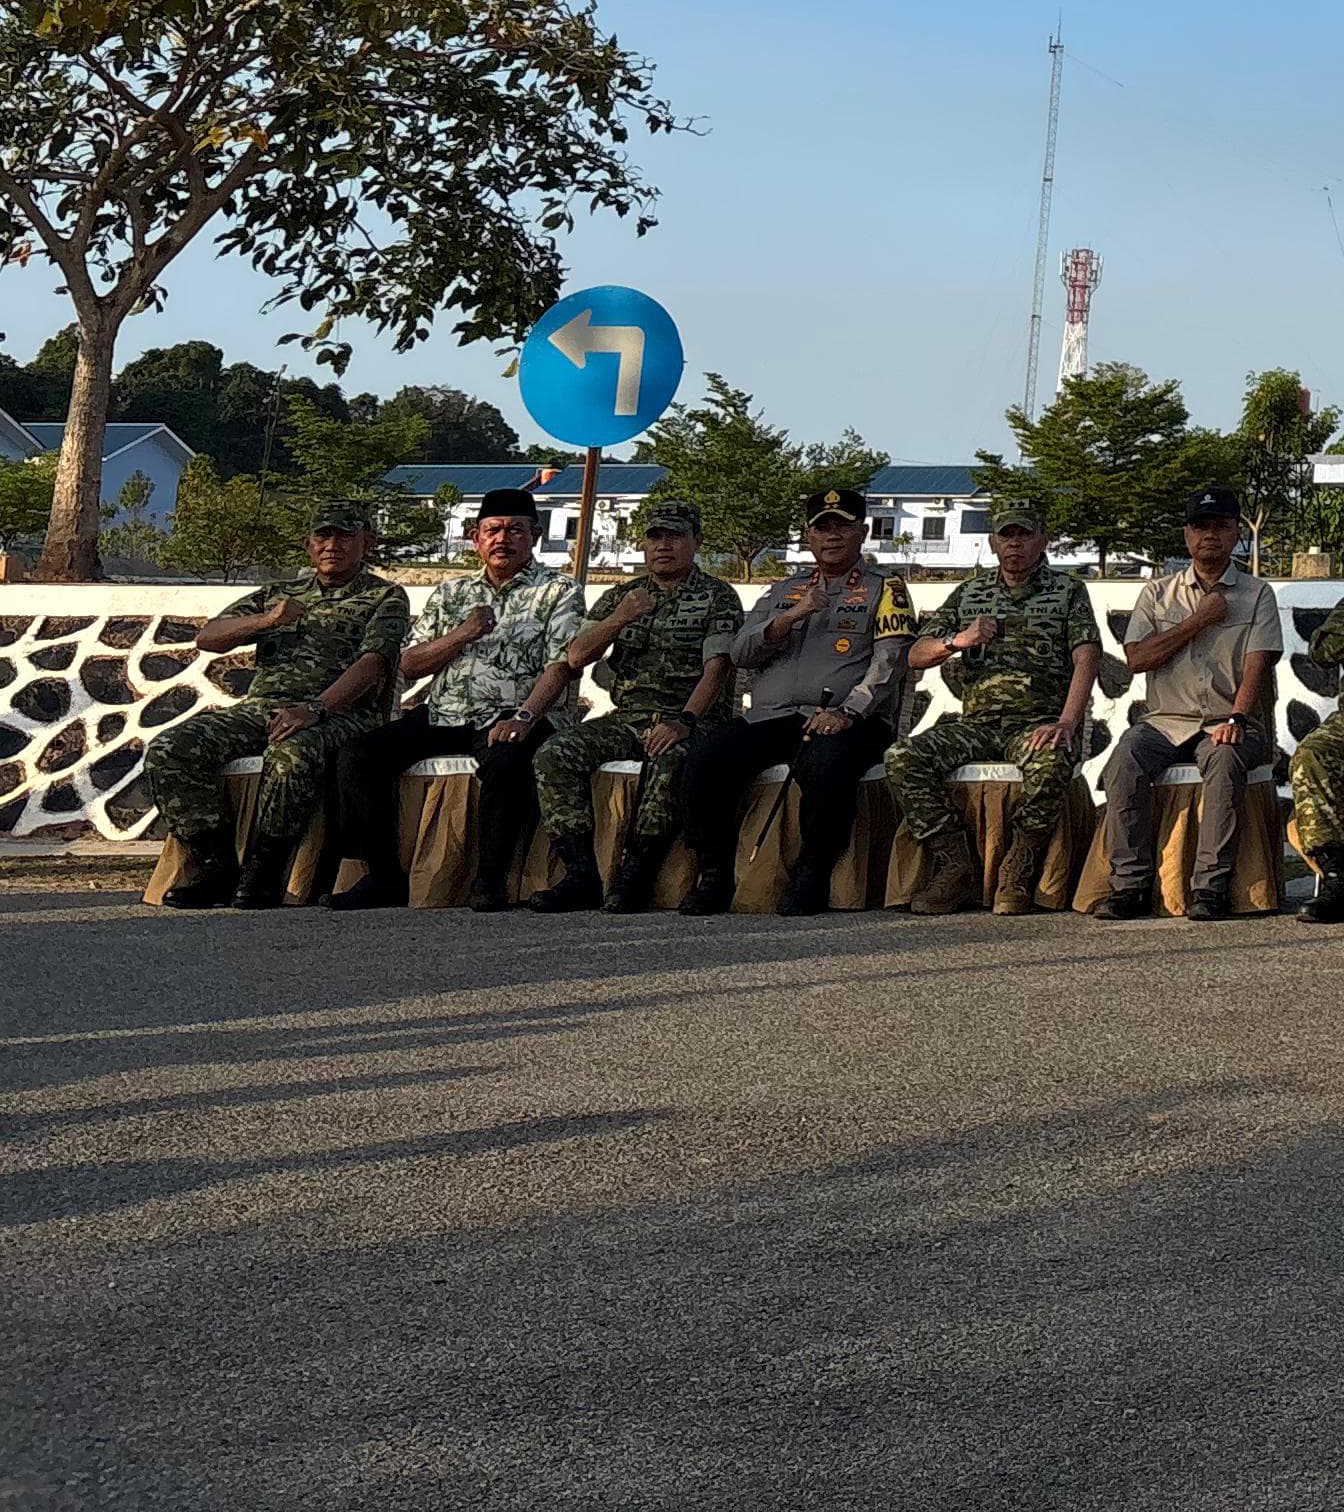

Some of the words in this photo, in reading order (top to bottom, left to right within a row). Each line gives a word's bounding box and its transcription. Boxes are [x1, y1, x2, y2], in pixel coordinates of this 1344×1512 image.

[961, 607, 993, 617] YAYAN
[1029, 606, 1048, 615] TNI
[1050, 606, 1065, 616] AL
